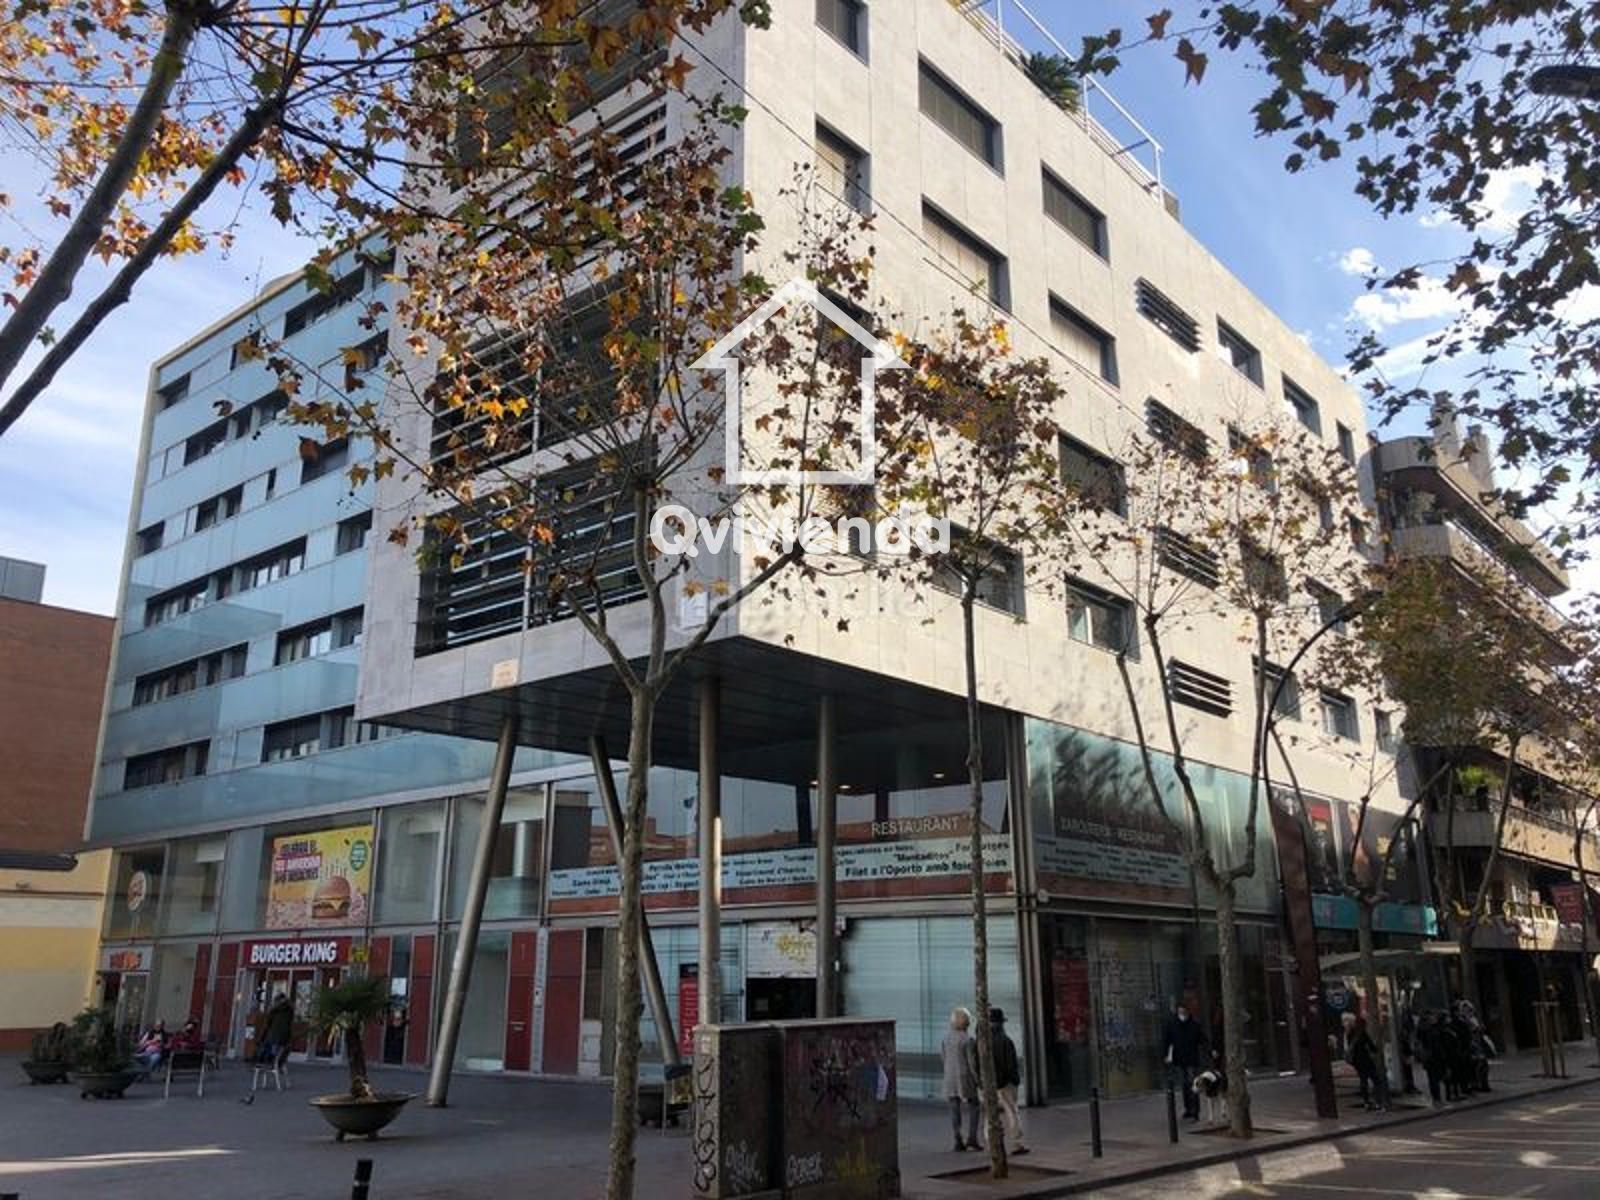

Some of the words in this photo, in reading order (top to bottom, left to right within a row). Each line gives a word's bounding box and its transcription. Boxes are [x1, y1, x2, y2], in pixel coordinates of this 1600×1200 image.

[871, 816, 959, 837] RESTAURANT
[925, 862, 949, 872] amb
[251, 943, 301, 963] BURGER
[301, 941, 337, 962] KING
